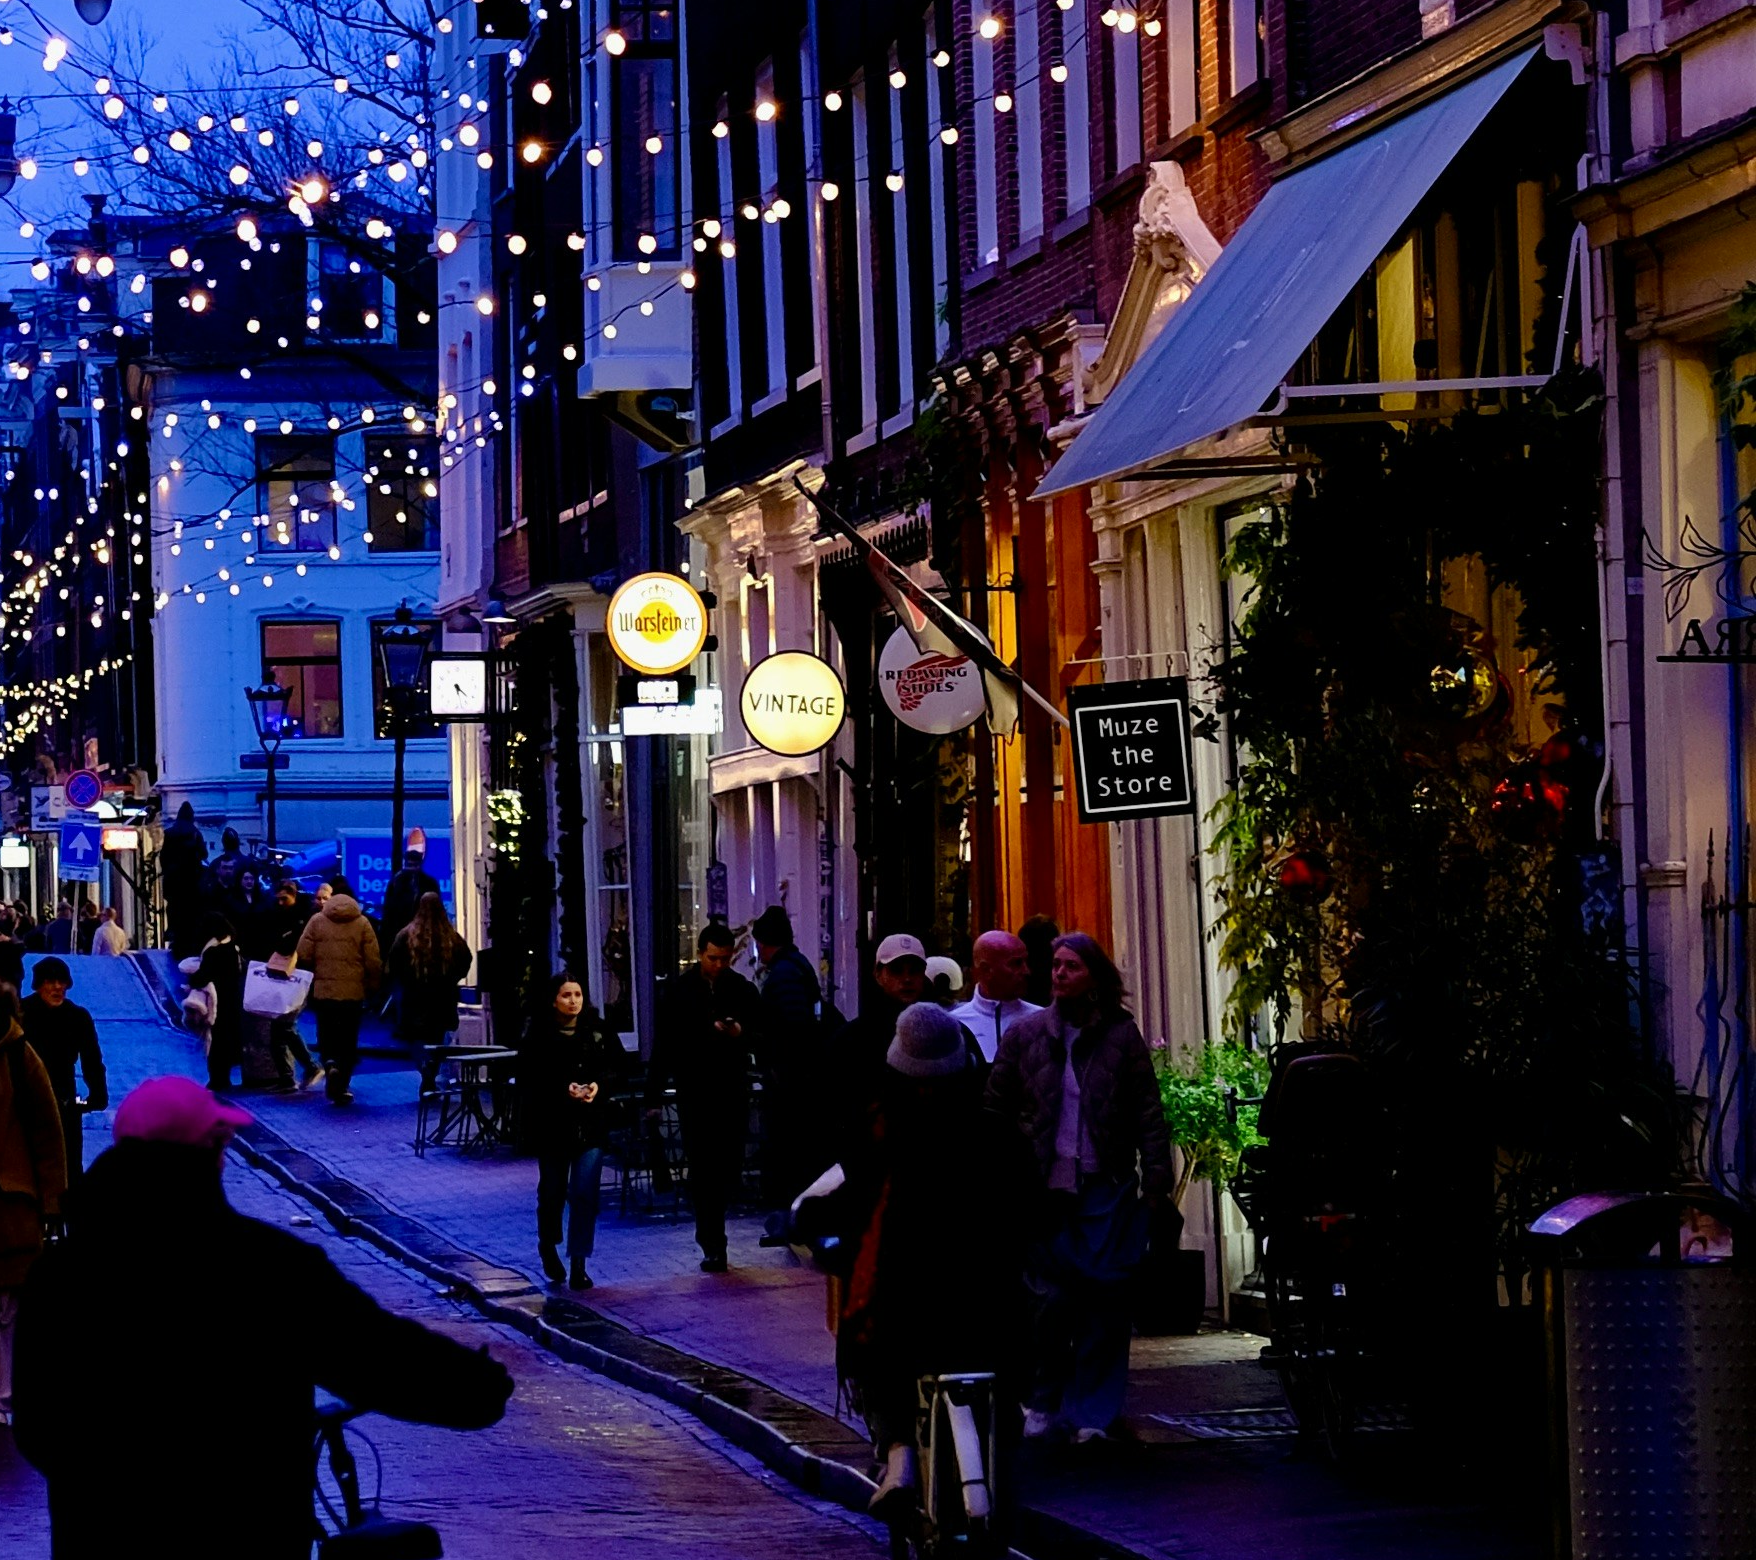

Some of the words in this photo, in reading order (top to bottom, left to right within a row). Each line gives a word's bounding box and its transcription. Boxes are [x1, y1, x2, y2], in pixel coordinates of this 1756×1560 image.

[619, 607, 696, 636] Warsteiner
[885, 669, 917, 681] RED
[922, 666, 968, 679] WING
[901, 681, 955, 694] SHOES
[748, 691, 836, 717] VINTAGE
[1098, 716, 1160, 738] Muze
[1110, 745, 1155, 766] the
[1097, 775, 1173, 797] Store
